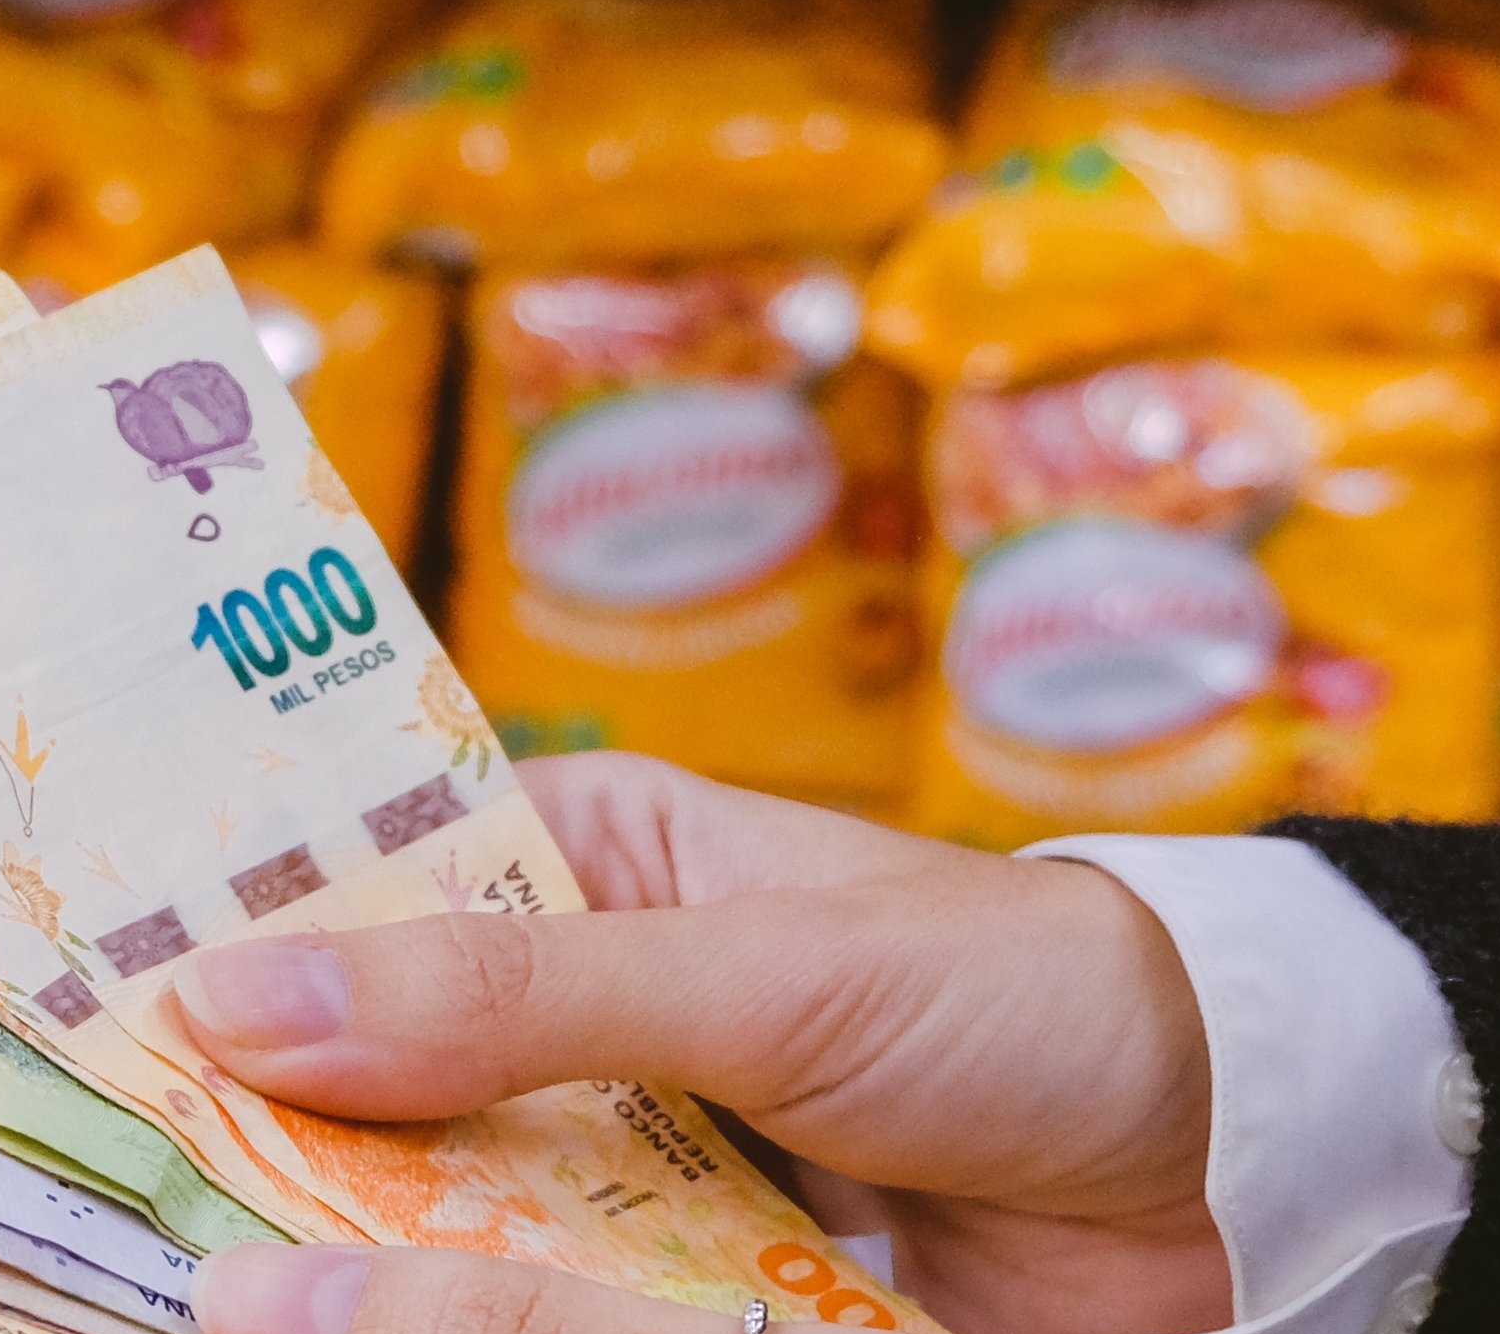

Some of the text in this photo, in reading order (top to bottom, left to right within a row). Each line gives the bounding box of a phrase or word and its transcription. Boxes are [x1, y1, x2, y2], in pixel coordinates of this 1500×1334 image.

[191, 546, 377, 691] 1000
[269, 640, 396, 715] MIL PESOS
[613, 1100, 701, 1183] BANCO
